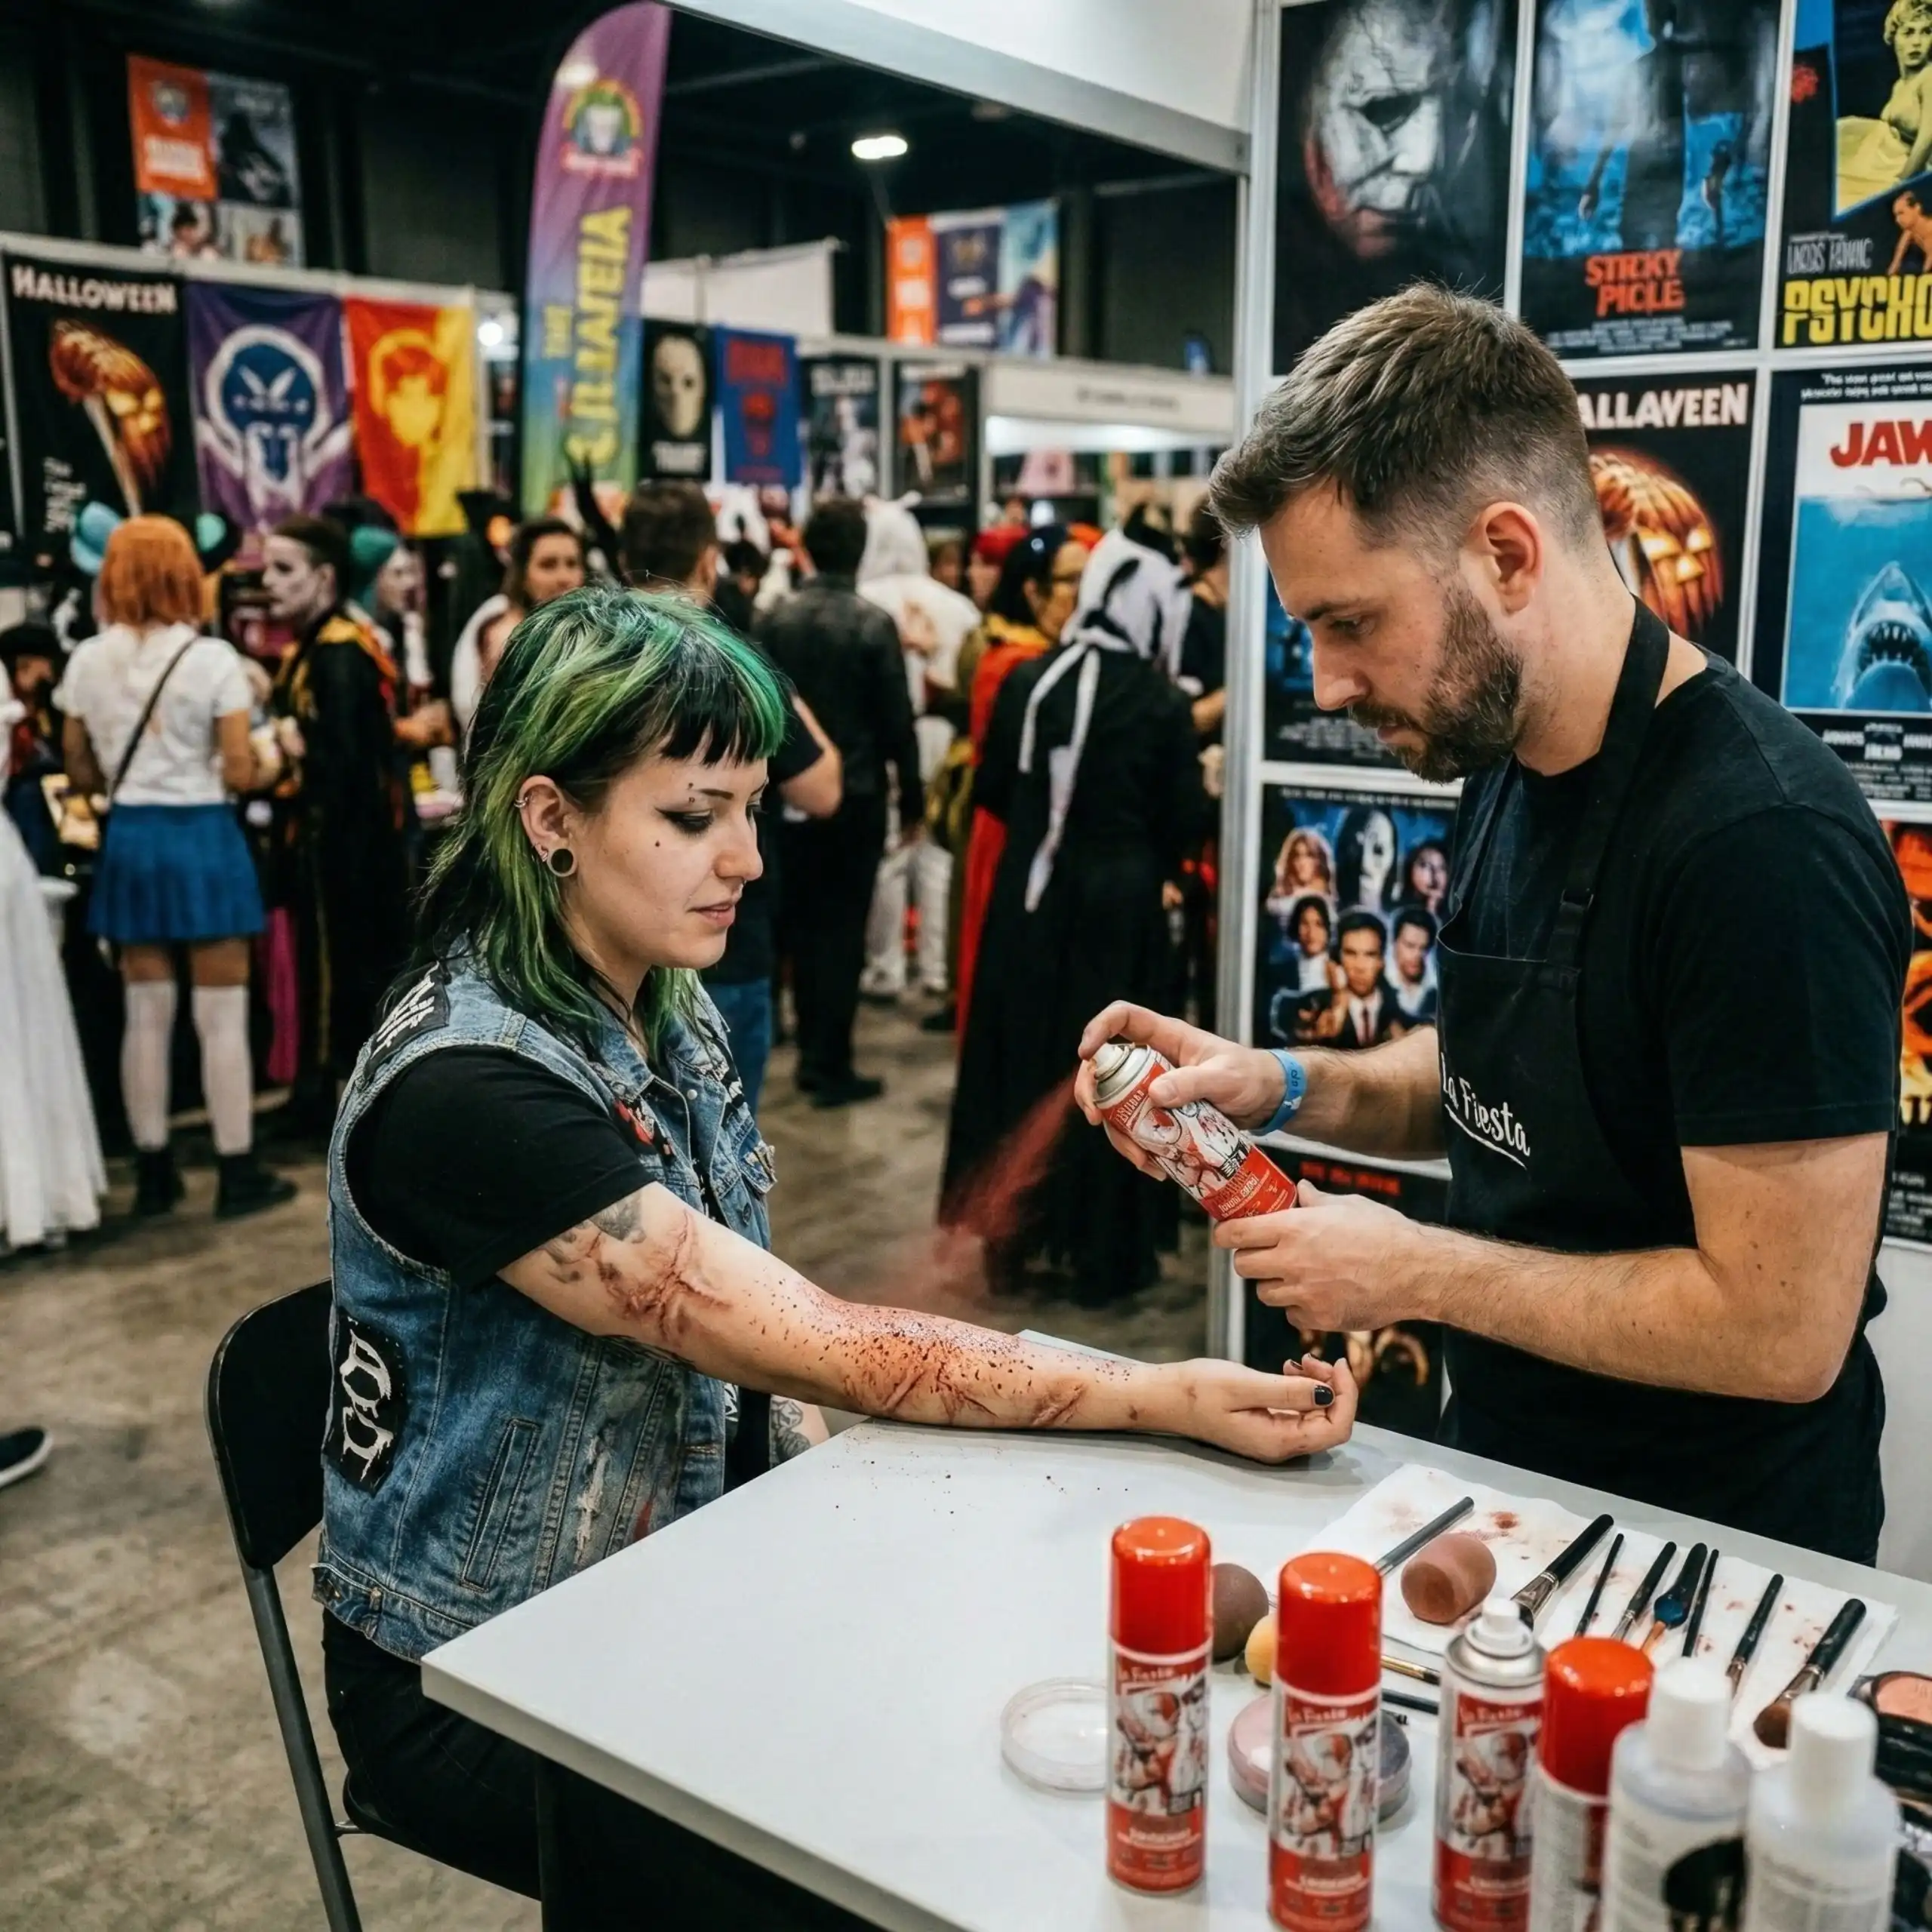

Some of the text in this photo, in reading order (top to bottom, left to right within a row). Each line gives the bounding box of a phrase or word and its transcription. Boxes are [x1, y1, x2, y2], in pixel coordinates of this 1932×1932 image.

[11, 264, 178, 315] HALLOWEEN
[1783, 274, 1932, 346] PSYCHO
[1441, 1051, 1531, 1157] La Fiesta
